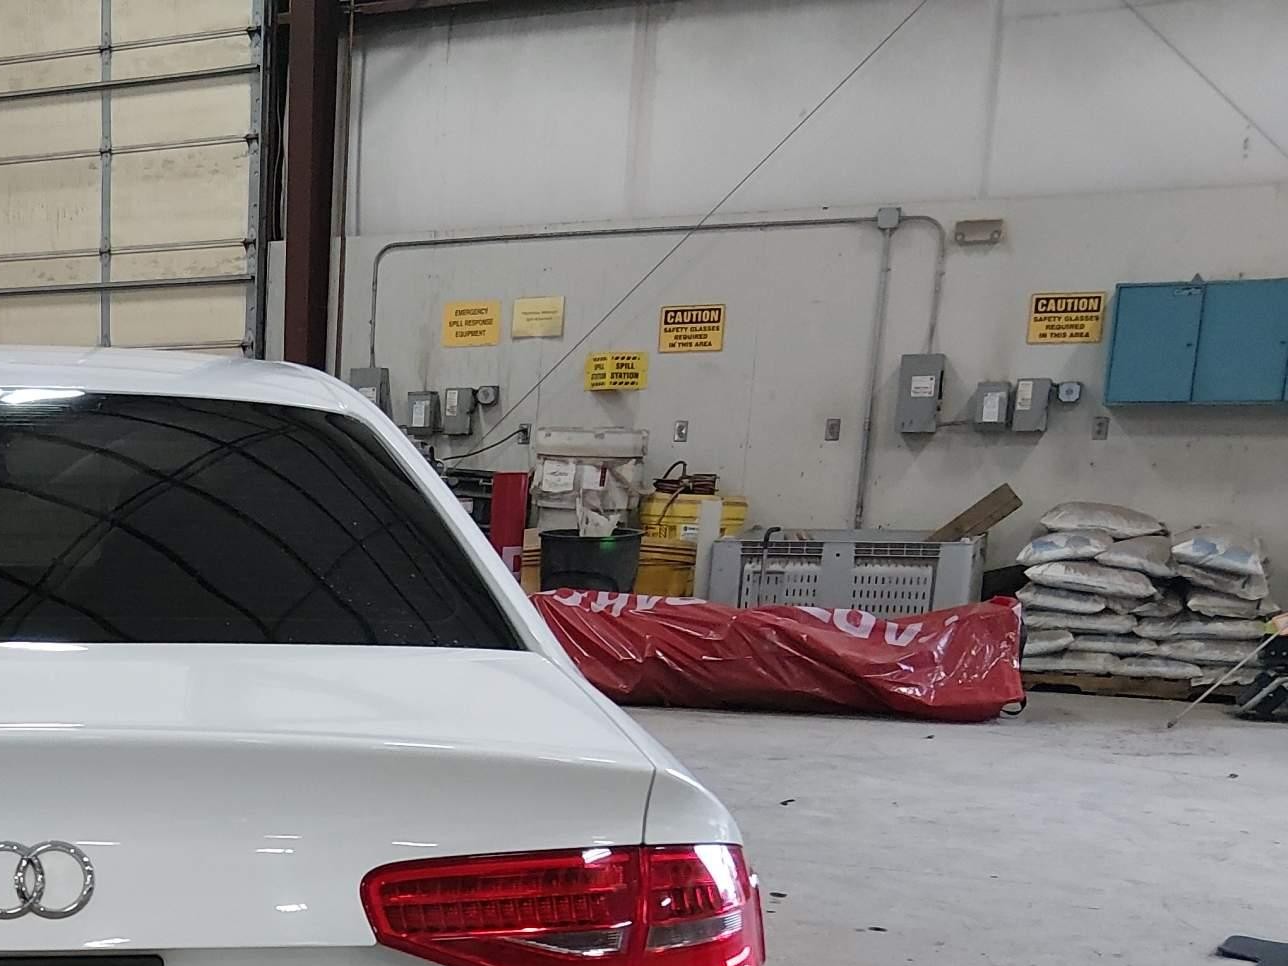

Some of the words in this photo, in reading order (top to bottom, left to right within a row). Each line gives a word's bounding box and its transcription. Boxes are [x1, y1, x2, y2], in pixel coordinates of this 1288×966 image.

[1037, 298, 1100, 311] CAUTION
[455, 307, 488, 316] EMERGENCY
[667, 310, 720, 323] CAUTION
[464, 318, 494, 326] RESPONSE
[455, 329, 487, 338] EQUIPMENT
[616, 362, 636, 370] SPILL
[611, 372, 640, 380] STATION
